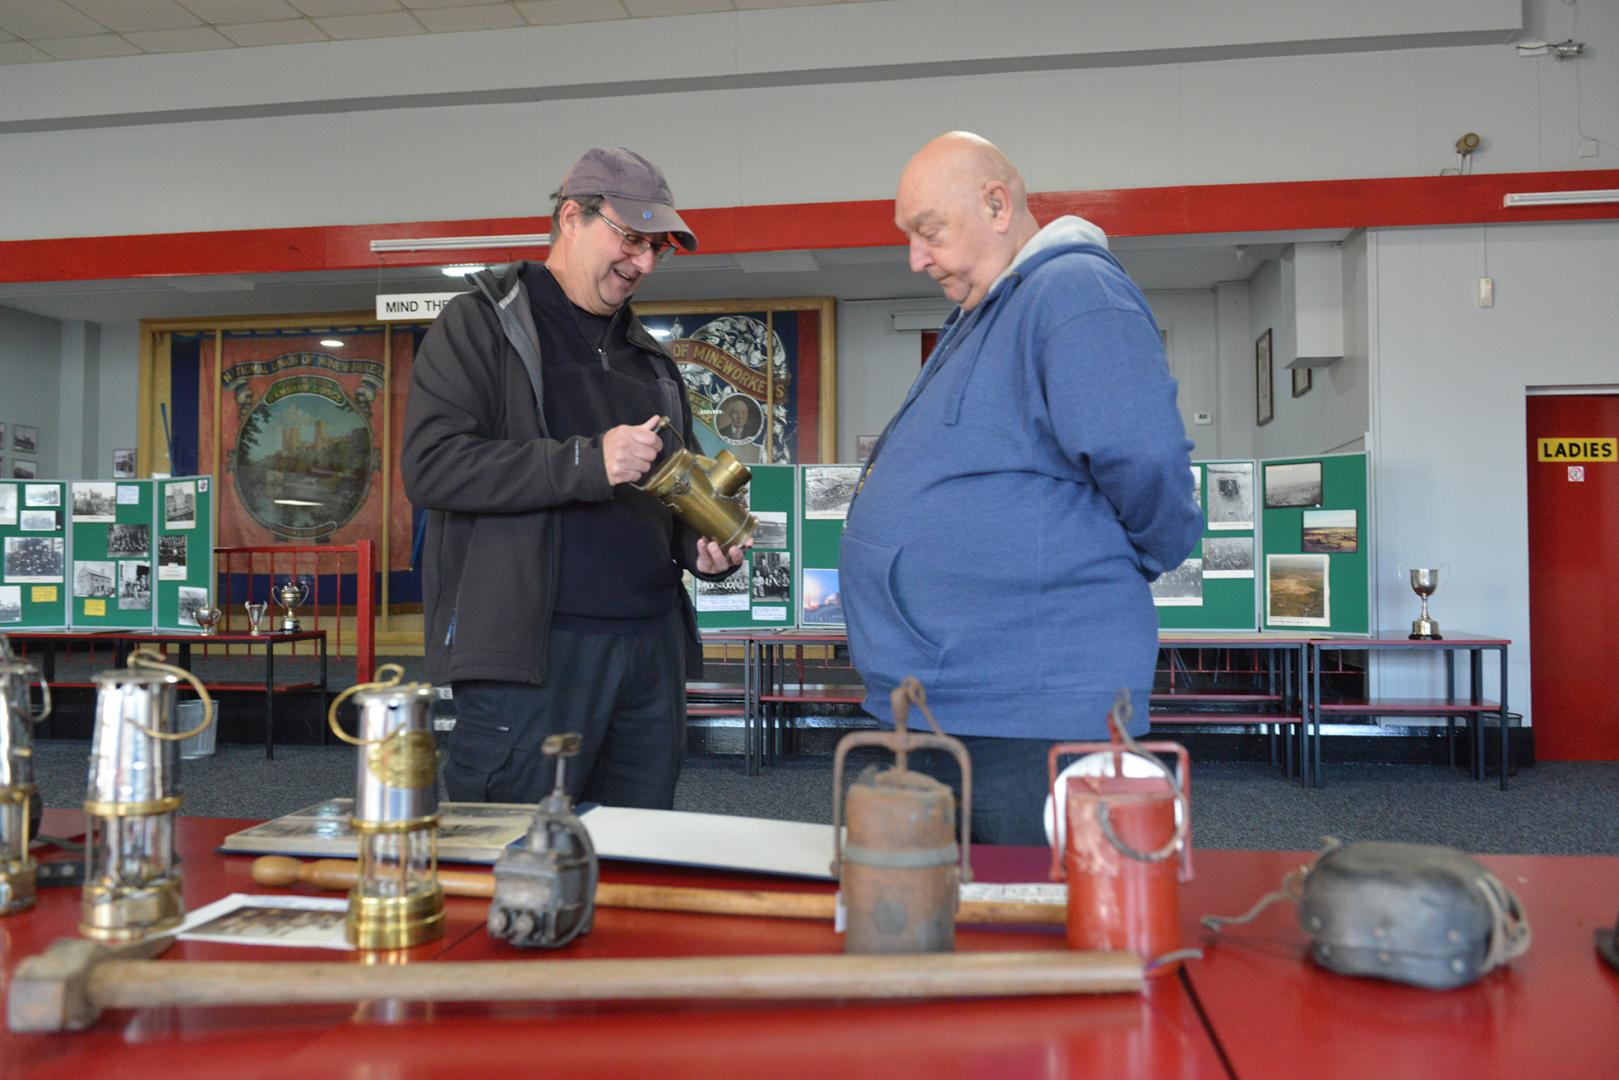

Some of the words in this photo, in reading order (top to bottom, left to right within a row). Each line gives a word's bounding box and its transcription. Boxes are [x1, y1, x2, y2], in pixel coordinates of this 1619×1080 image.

[386, 301, 419, 313] MIND
[673, 343, 689, 358] OF
[693, 345, 785, 398] MINEWORKES
[1543, 442, 1612, 458] LADIES
